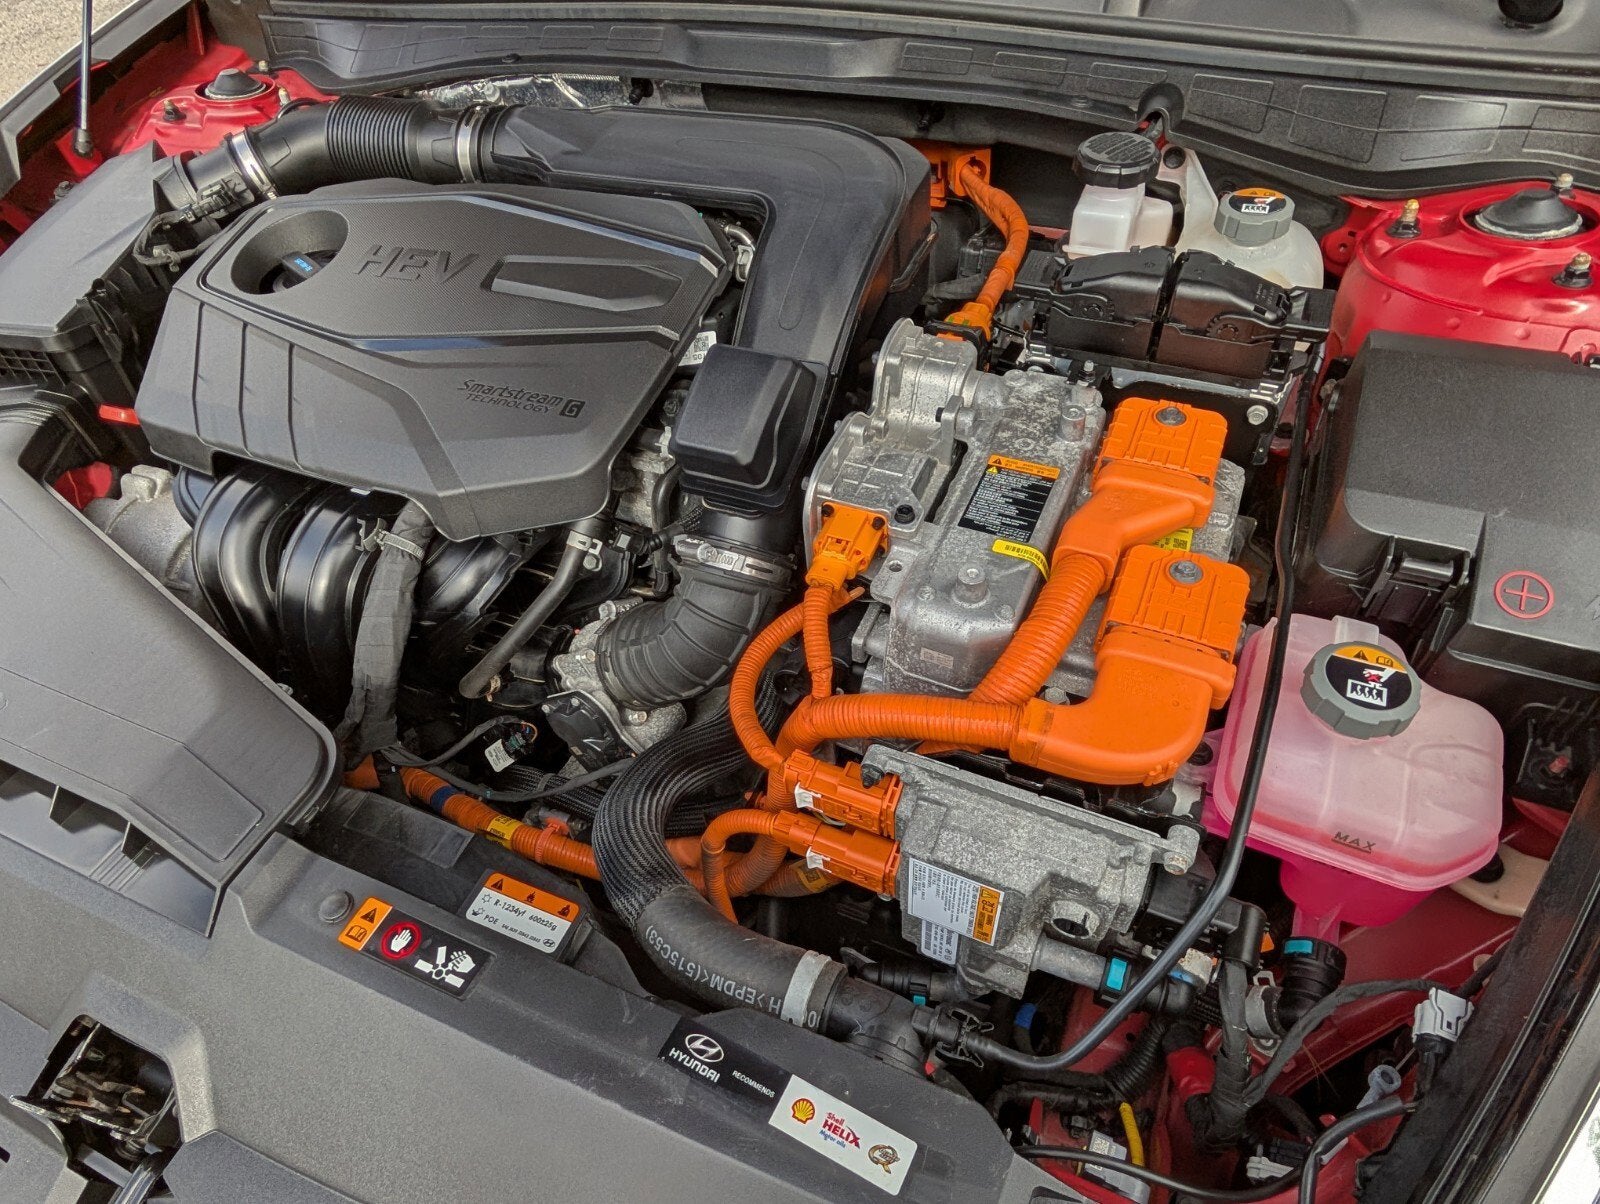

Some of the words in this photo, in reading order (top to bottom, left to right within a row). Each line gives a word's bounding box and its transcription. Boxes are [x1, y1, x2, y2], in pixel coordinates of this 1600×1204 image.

[354, 244, 479, 284] HEV
[458, 379, 564, 407] Smartstream
[465, 393, 553, 414] TECHNOLOGY
[1334, 831, 1376, 851] MAX
[483, 914, 500, 925] POE
[493, 899, 527, 917] R-1234yf
[669, 1047, 720, 1083] HYUNDAI
[732, 1070, 776, 1098] RECOMMENDS
[826, 1112, 845, 1126] Shell
[822, 1119, 860, 1149] HELIX
